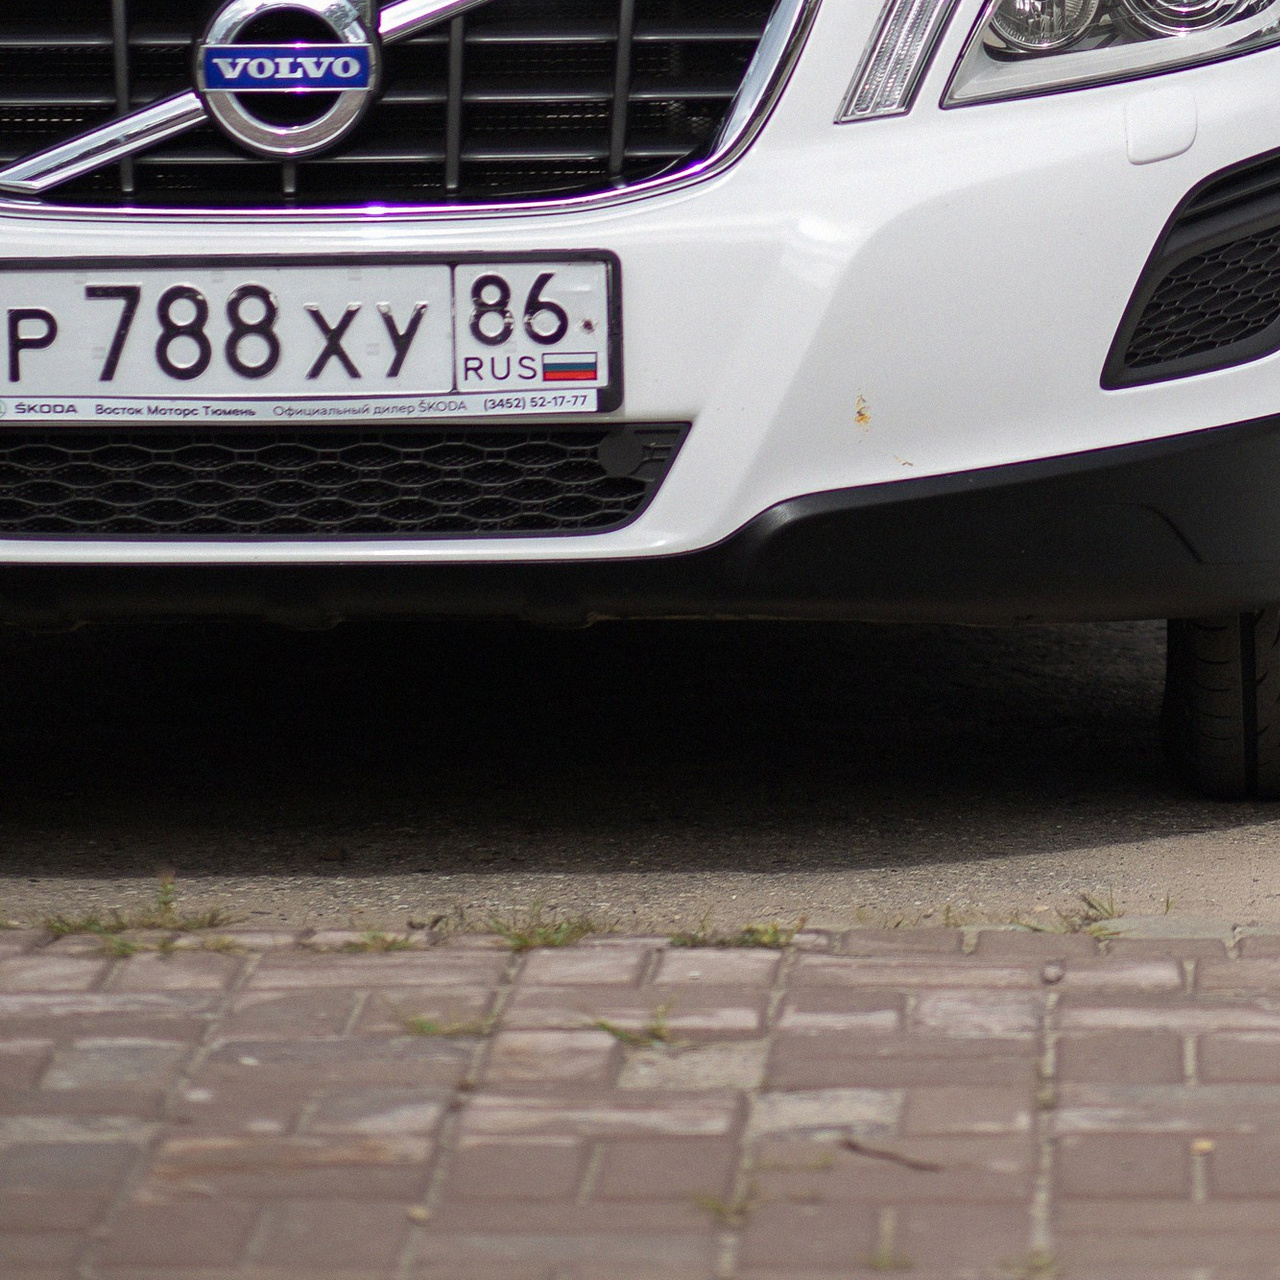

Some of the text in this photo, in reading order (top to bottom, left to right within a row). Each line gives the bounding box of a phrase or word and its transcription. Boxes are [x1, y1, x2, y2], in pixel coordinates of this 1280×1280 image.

[212, 57, 361, 79] VOLVO
[469, 273, 569, 346] 86
[463, 355, 537, 381] RUS
[14, 394, 588, 419] ŠKODA Восток Моторс Тюмень Официальный дилер ŠKODA (3452) 52-17-77
